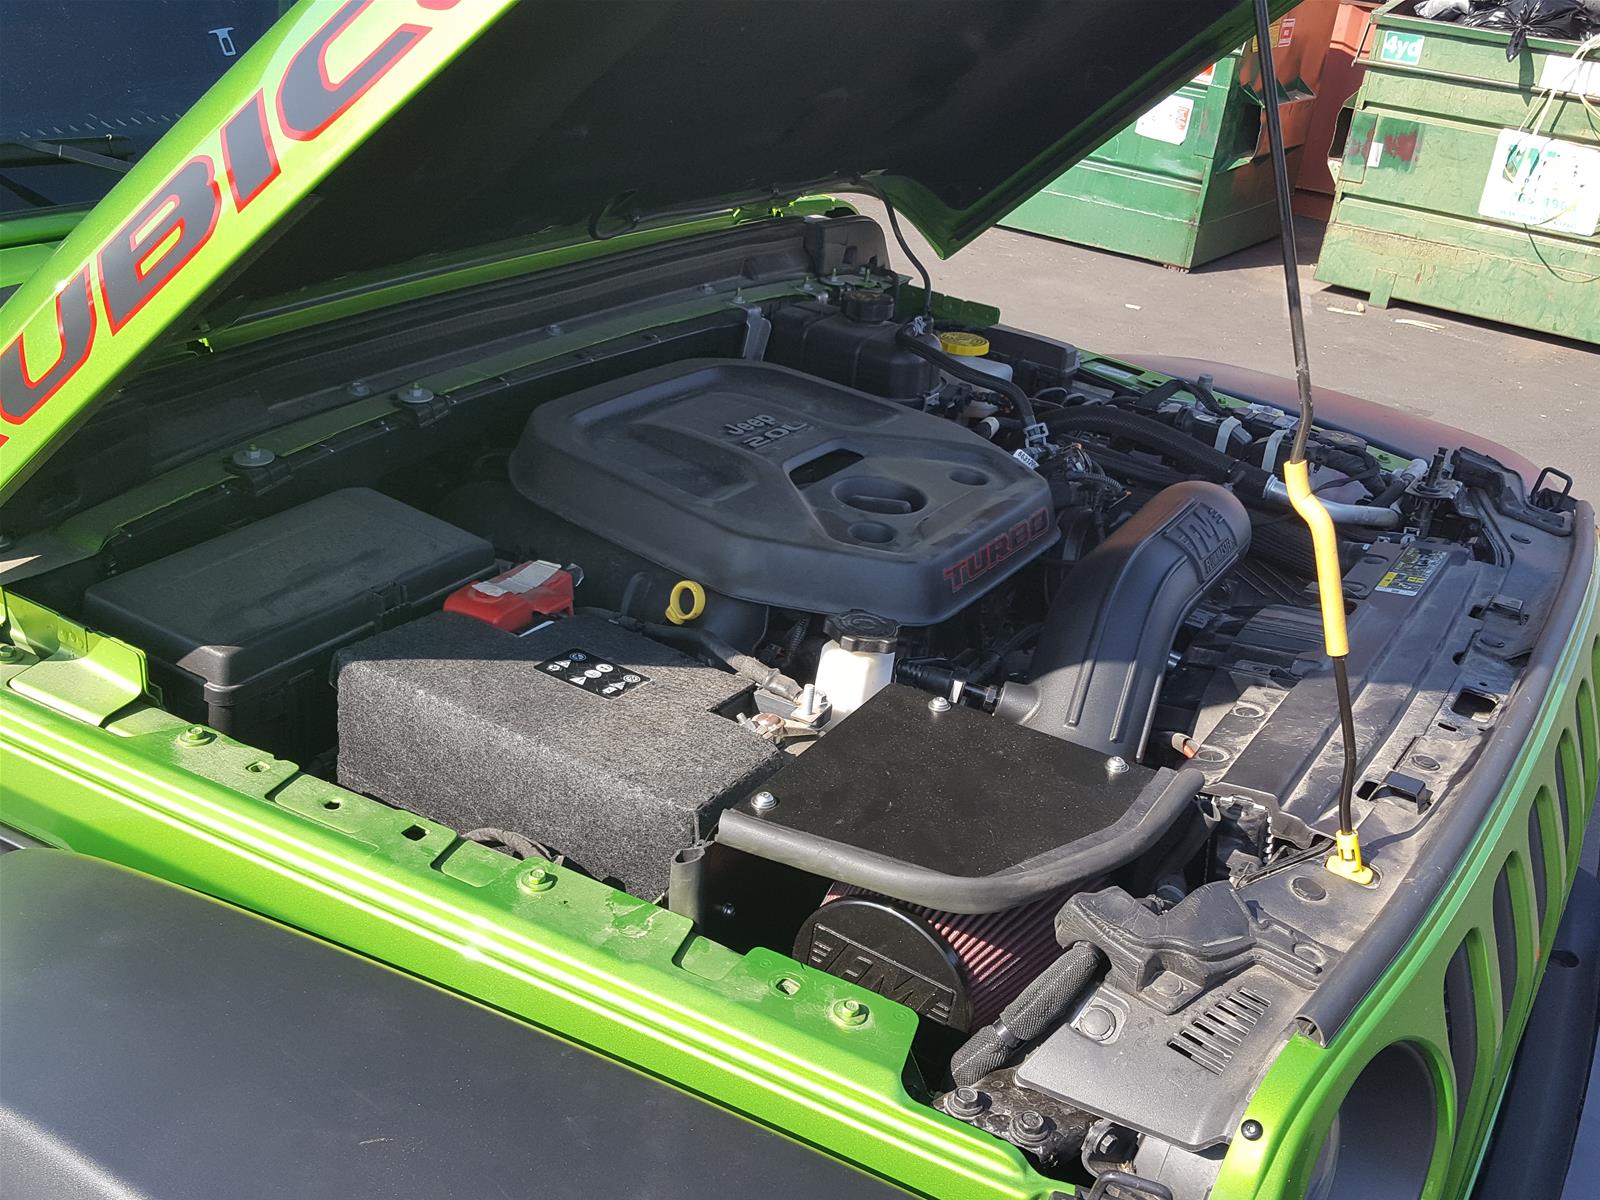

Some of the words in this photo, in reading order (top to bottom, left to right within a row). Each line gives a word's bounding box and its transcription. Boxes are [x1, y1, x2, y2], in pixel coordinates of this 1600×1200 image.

[1385, 35, 1424, 60] 4yd
[0, 0, 461, 447] UBIC
[725, 415, 776, 435] Jeep
[743, 423, 808, 448] 2.0L
[943, 507, 1049, 593] TURBO
